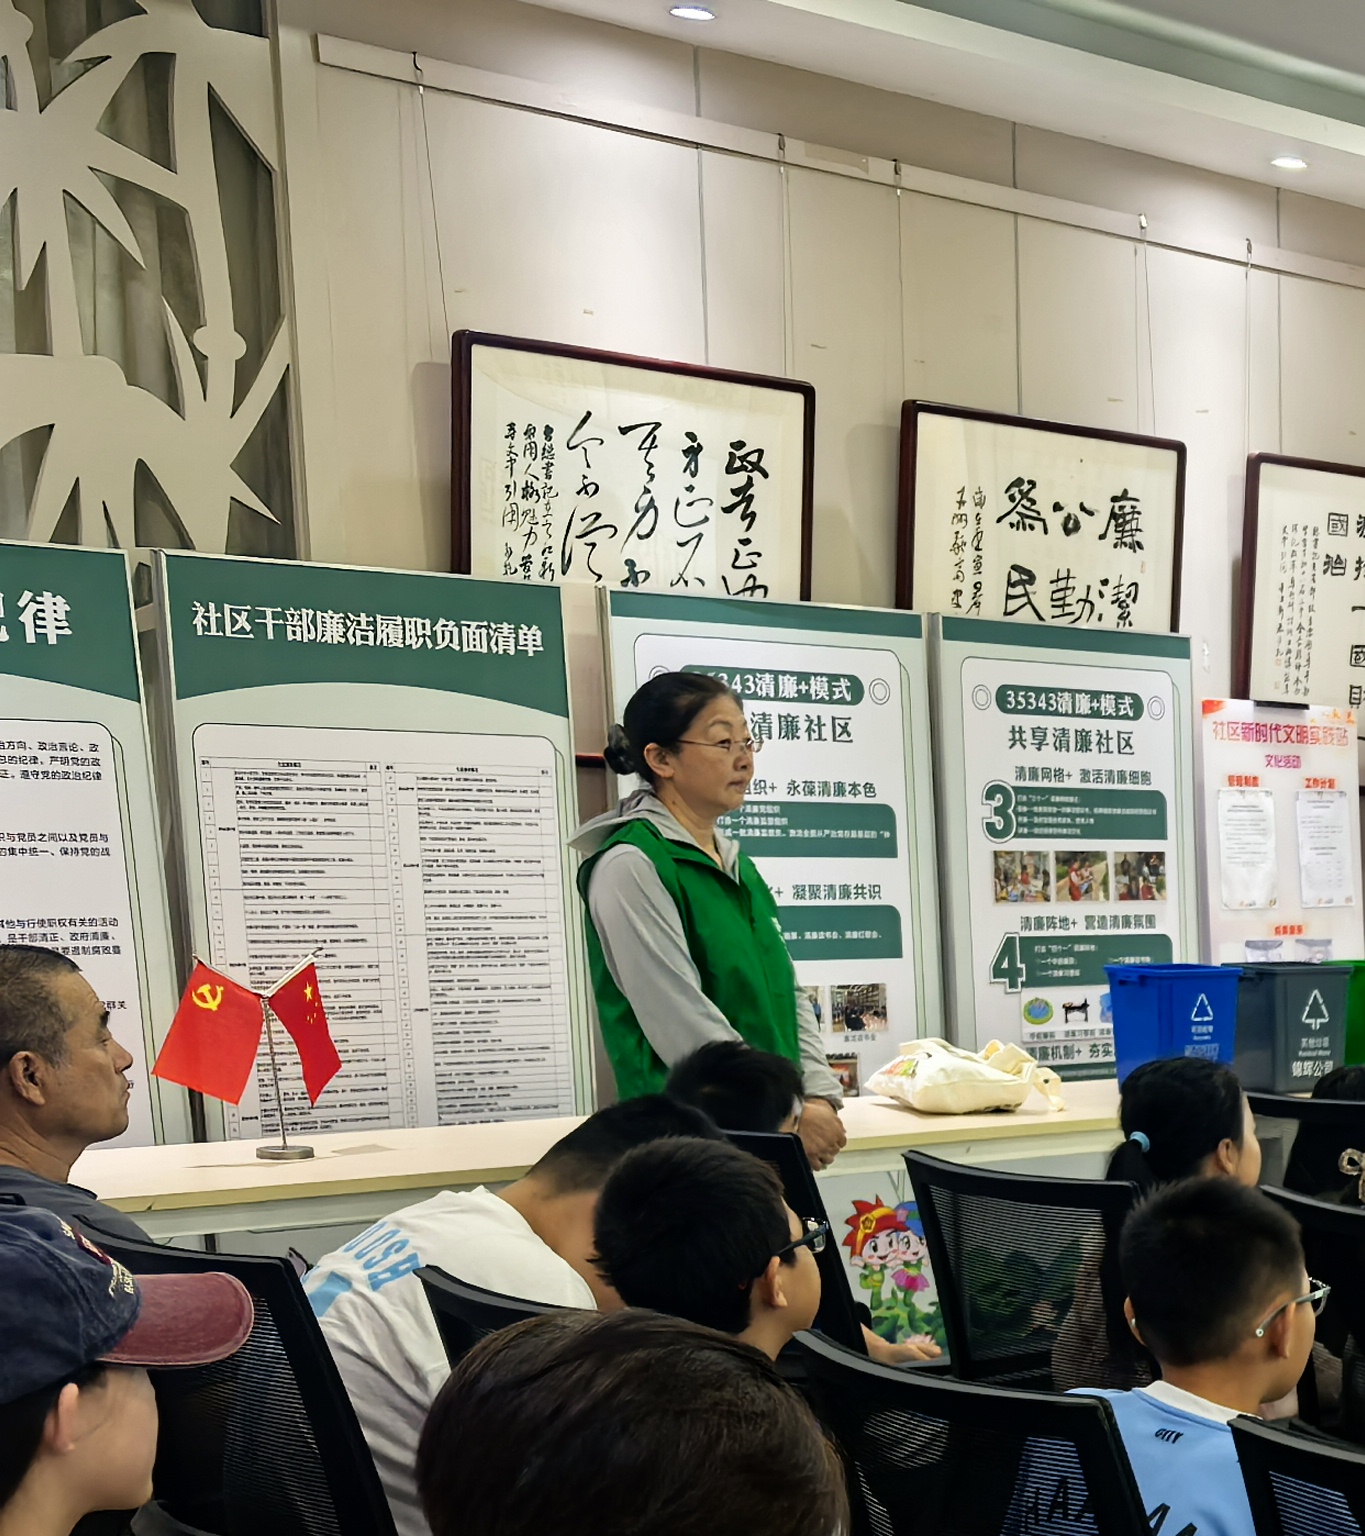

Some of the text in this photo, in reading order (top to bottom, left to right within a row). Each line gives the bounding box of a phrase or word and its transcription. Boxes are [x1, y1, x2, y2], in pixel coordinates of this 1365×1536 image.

[0, 590, 73, 645] 律
[192, 600, 545, 657] 社区干部廉洁履职负面清单
[1006, 690, 1135, 717] 35343清廉+模式
[1008, 725, 1135, 756] 共享清廉社区
[1213, 720, 1349, 747] 社区新时代文明实践站
[786, 779, 877, 798] 永葆清廉本色
[982, 779, 1017, 843] 3
[792, 884, 882, 901] 凝聚清廉共识
[990, 932, 1026, 995] 4
[1155, 1428, 1185, 1444] CITY
